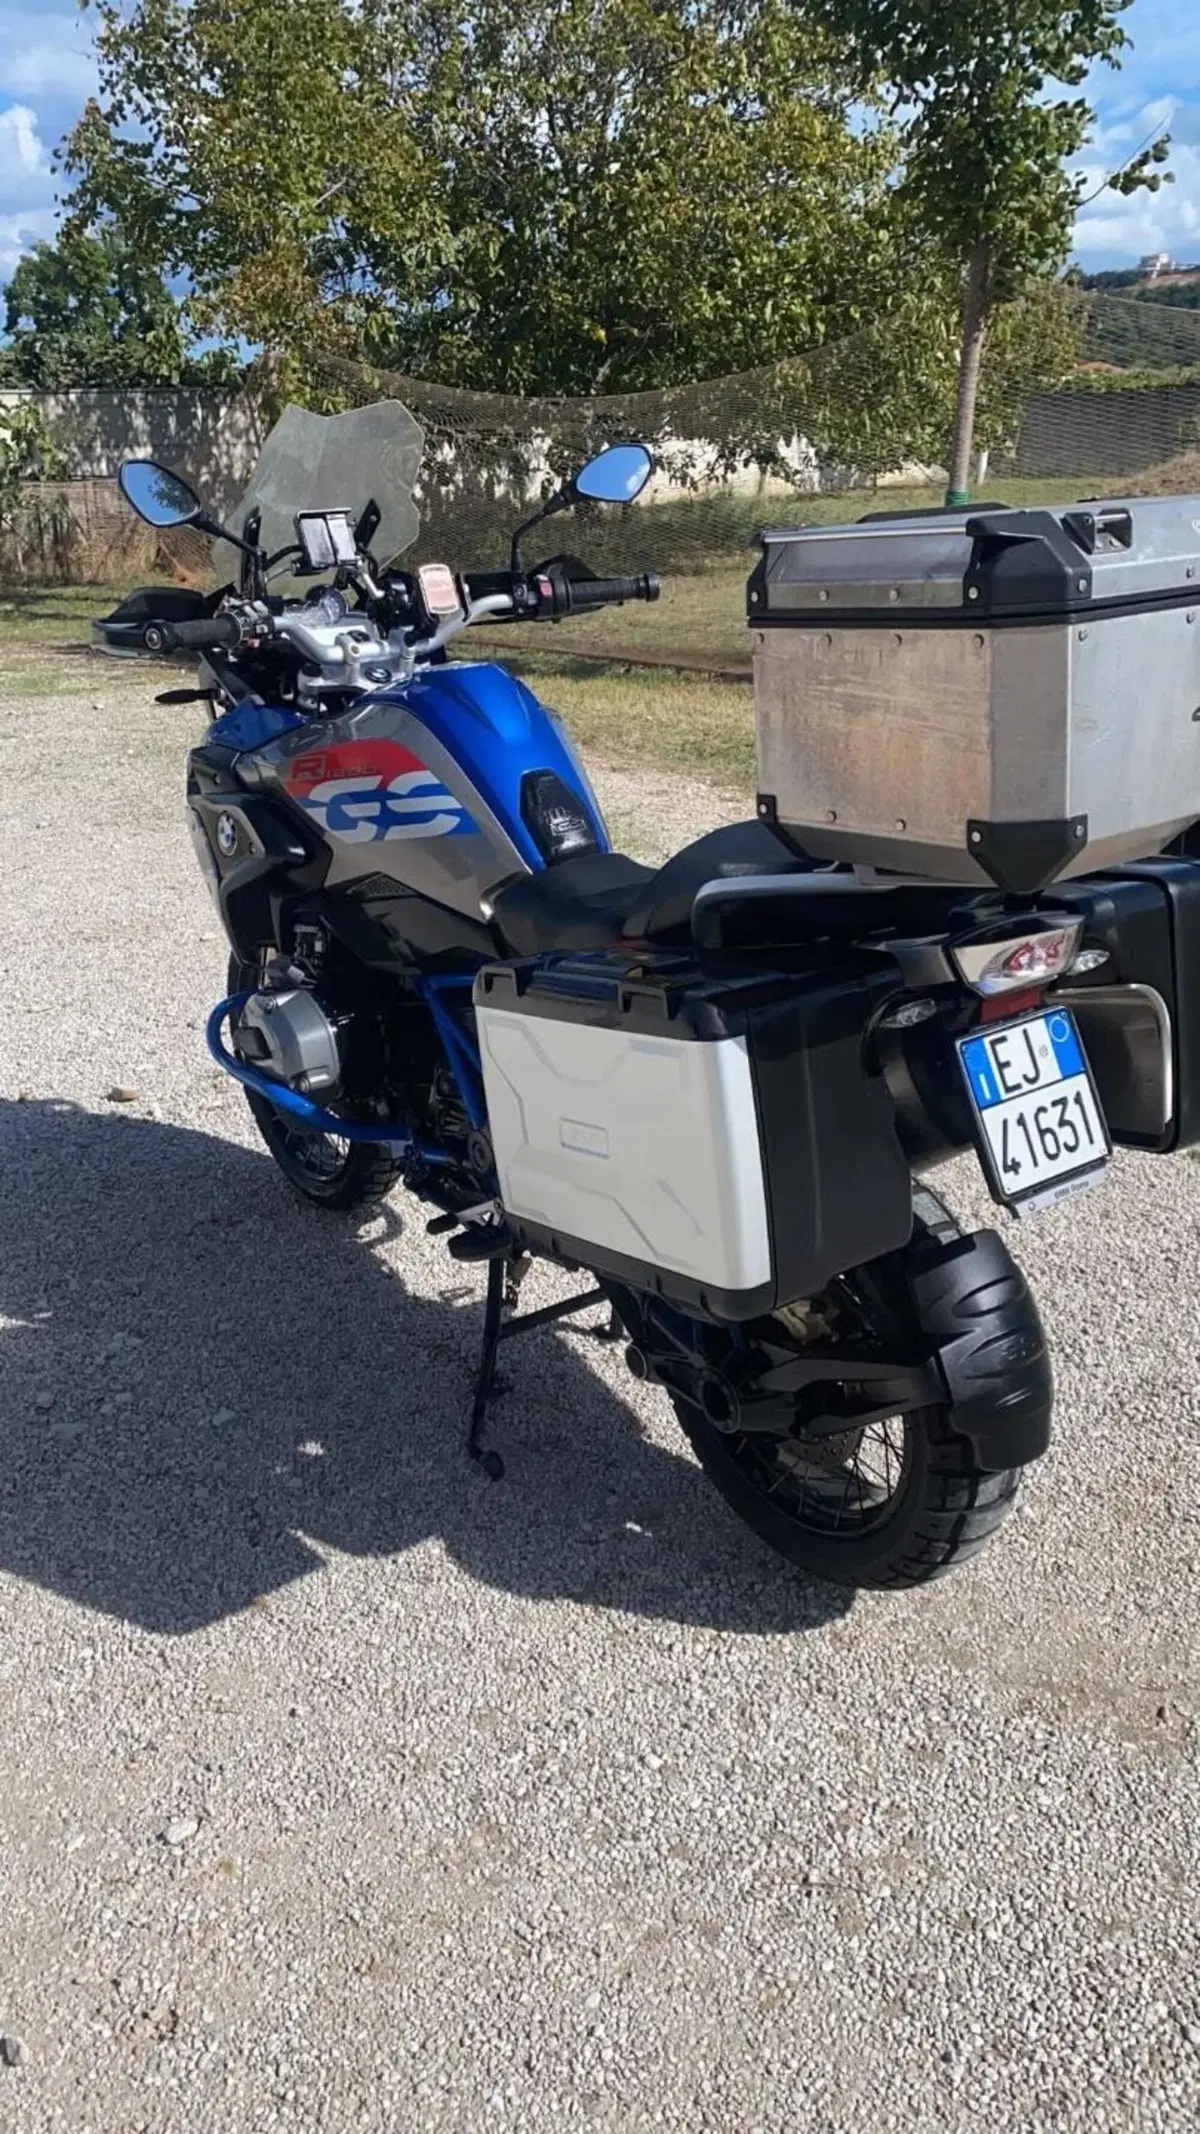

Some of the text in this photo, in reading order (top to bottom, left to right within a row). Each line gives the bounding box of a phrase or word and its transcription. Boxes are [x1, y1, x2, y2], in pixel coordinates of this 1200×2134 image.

[304, 770, 463, 844] GS
[988, 1027, 1042, 1094] EJ
[1001, 1090, 1095, 1176] 41631
